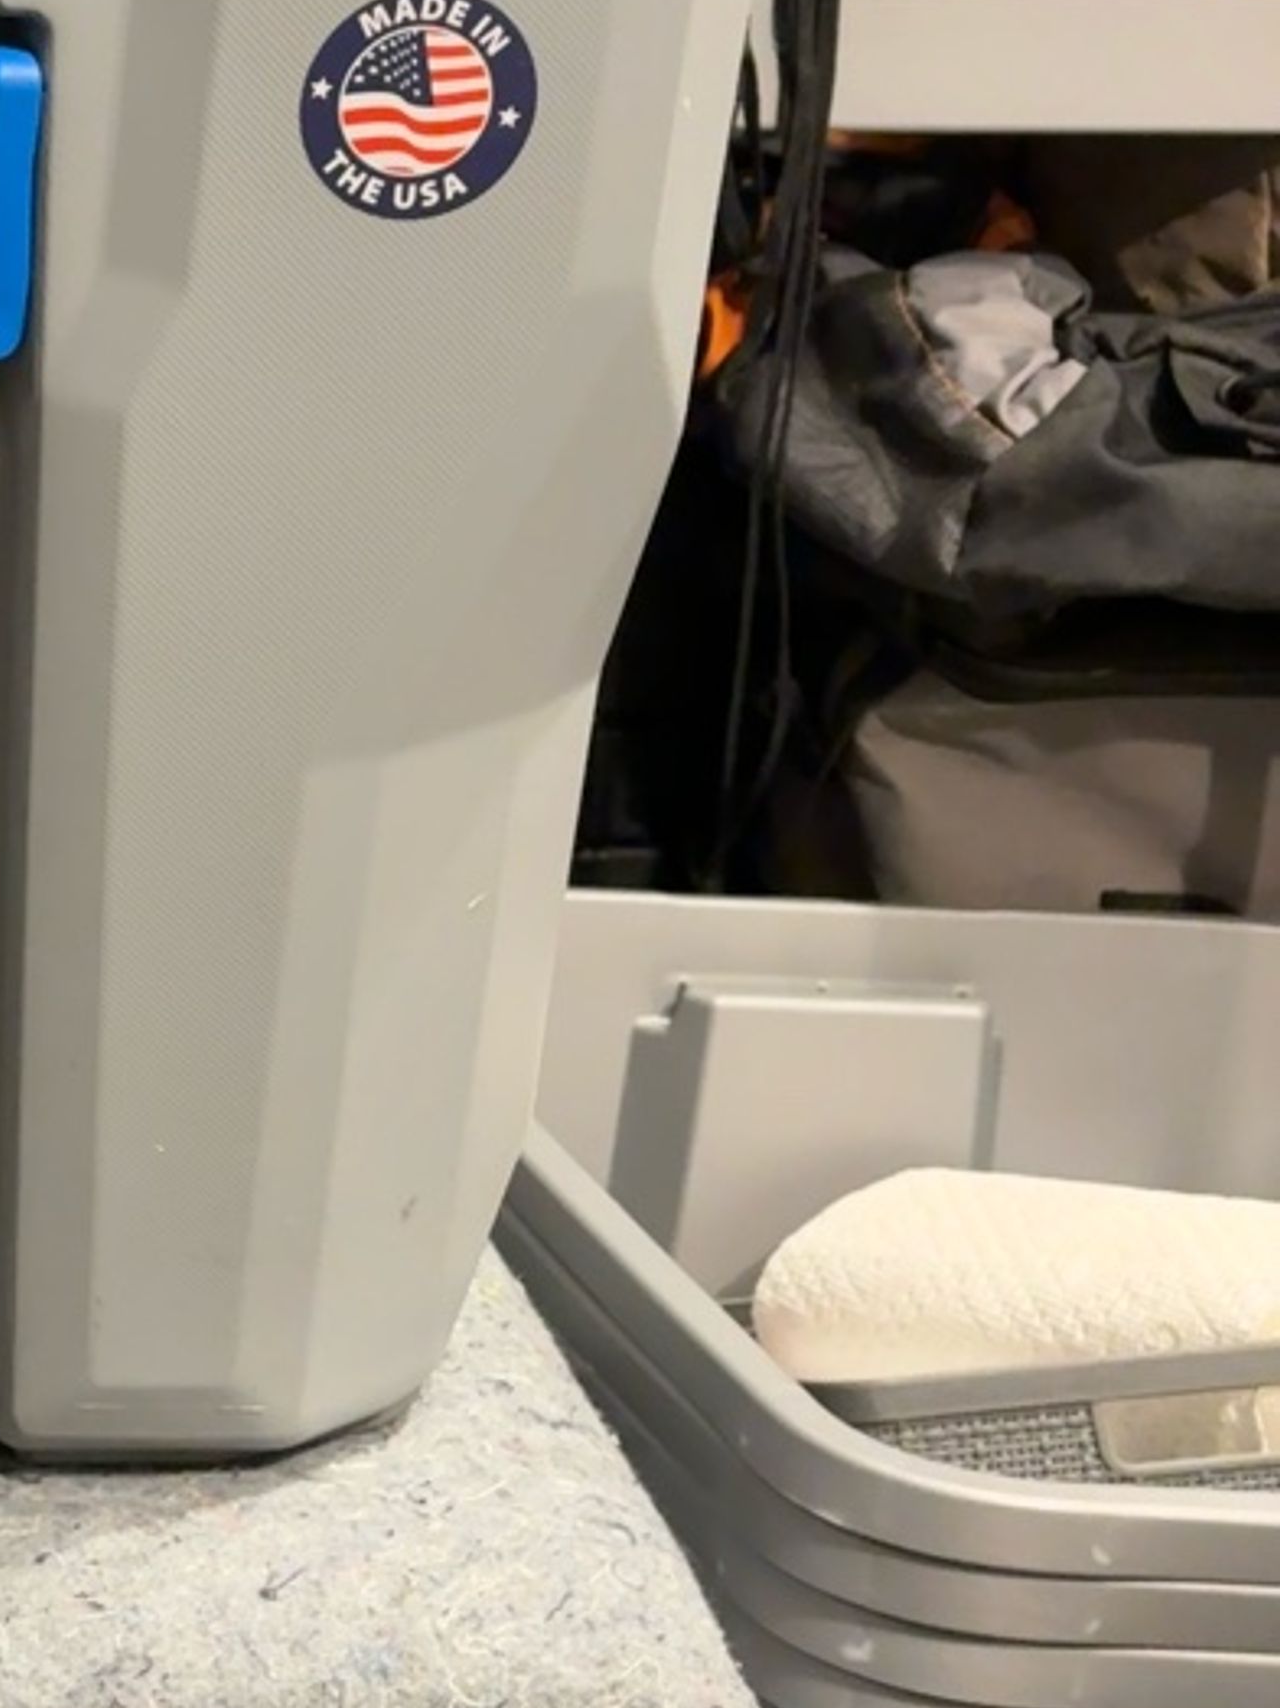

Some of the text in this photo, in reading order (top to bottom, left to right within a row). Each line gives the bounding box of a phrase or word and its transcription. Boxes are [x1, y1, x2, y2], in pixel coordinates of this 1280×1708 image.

[469, 14, 512, 58] IN
[321, 148, 469, 211] THE USA
